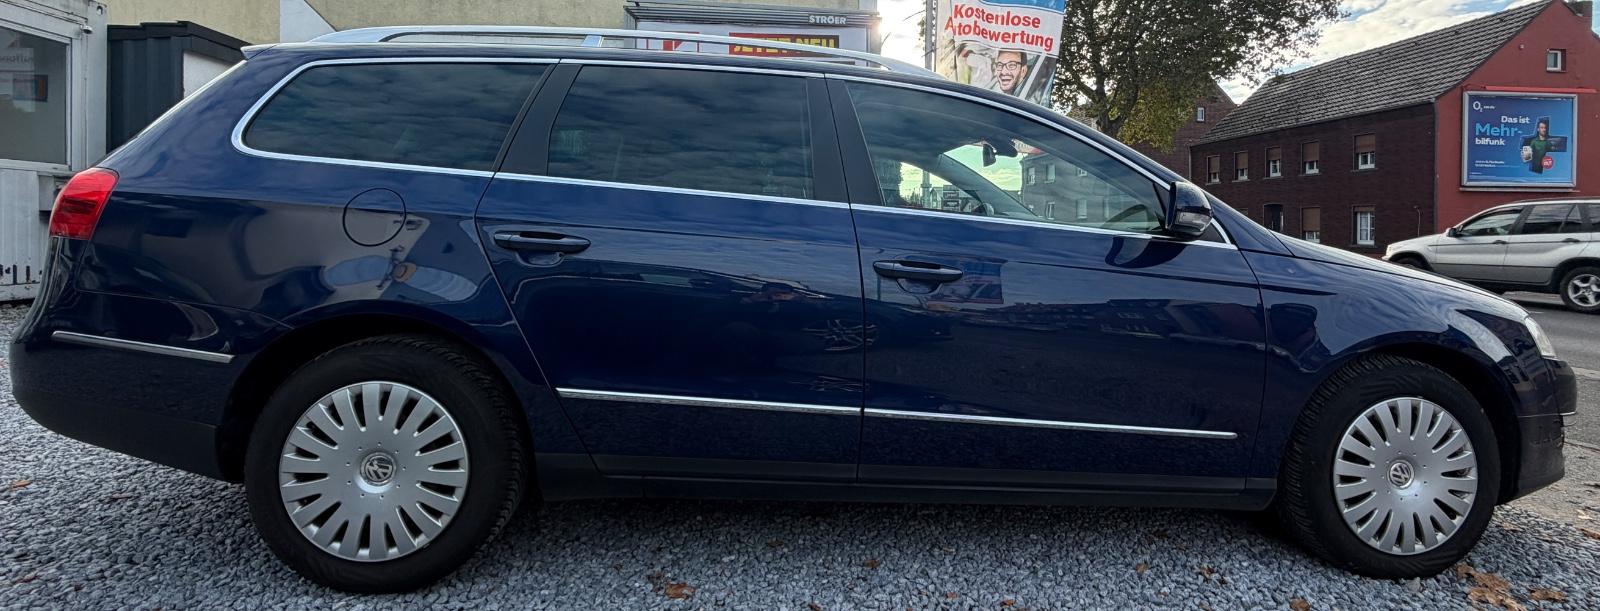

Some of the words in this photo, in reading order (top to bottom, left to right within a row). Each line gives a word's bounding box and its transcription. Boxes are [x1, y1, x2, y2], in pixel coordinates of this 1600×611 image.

[953, 4, 1041, 28] Kostenlose
[1501, 115, 1518, 123] Das
[1519, 115, 1530, 124] ist
[1475, 122, 1522, 137] Mehr-
[1475, 137, 1505, 146] bilfunk
